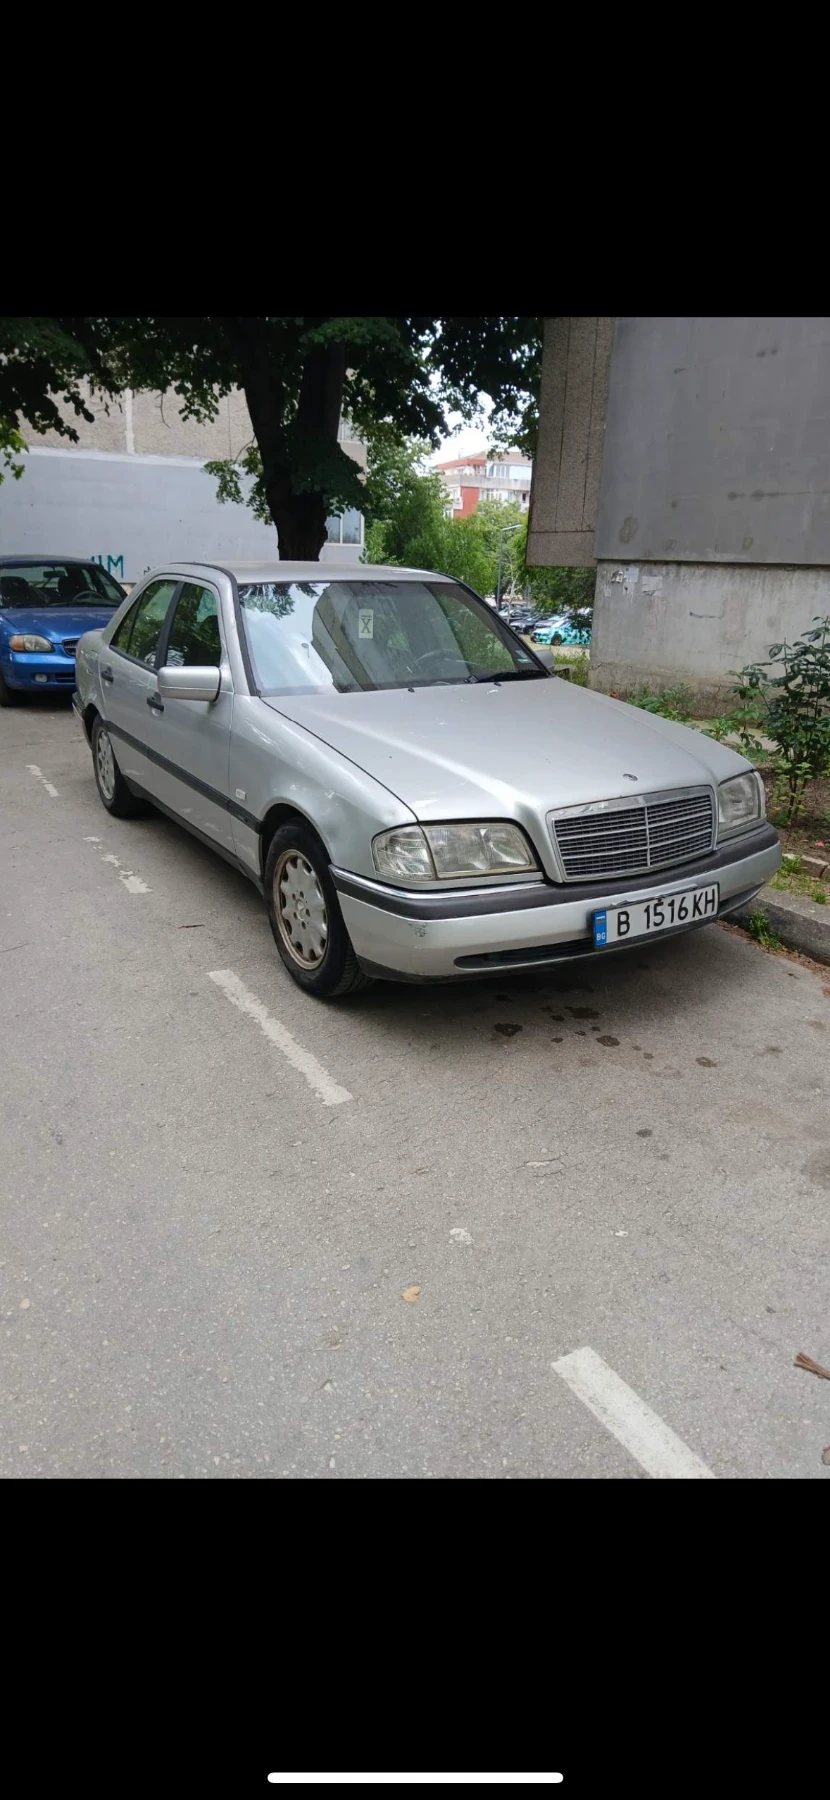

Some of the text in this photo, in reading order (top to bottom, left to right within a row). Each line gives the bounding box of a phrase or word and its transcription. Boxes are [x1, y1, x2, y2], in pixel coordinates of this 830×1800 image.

[617, 888, 715, 937] B 1516 KH
[596, 932, 606, 941] BG
